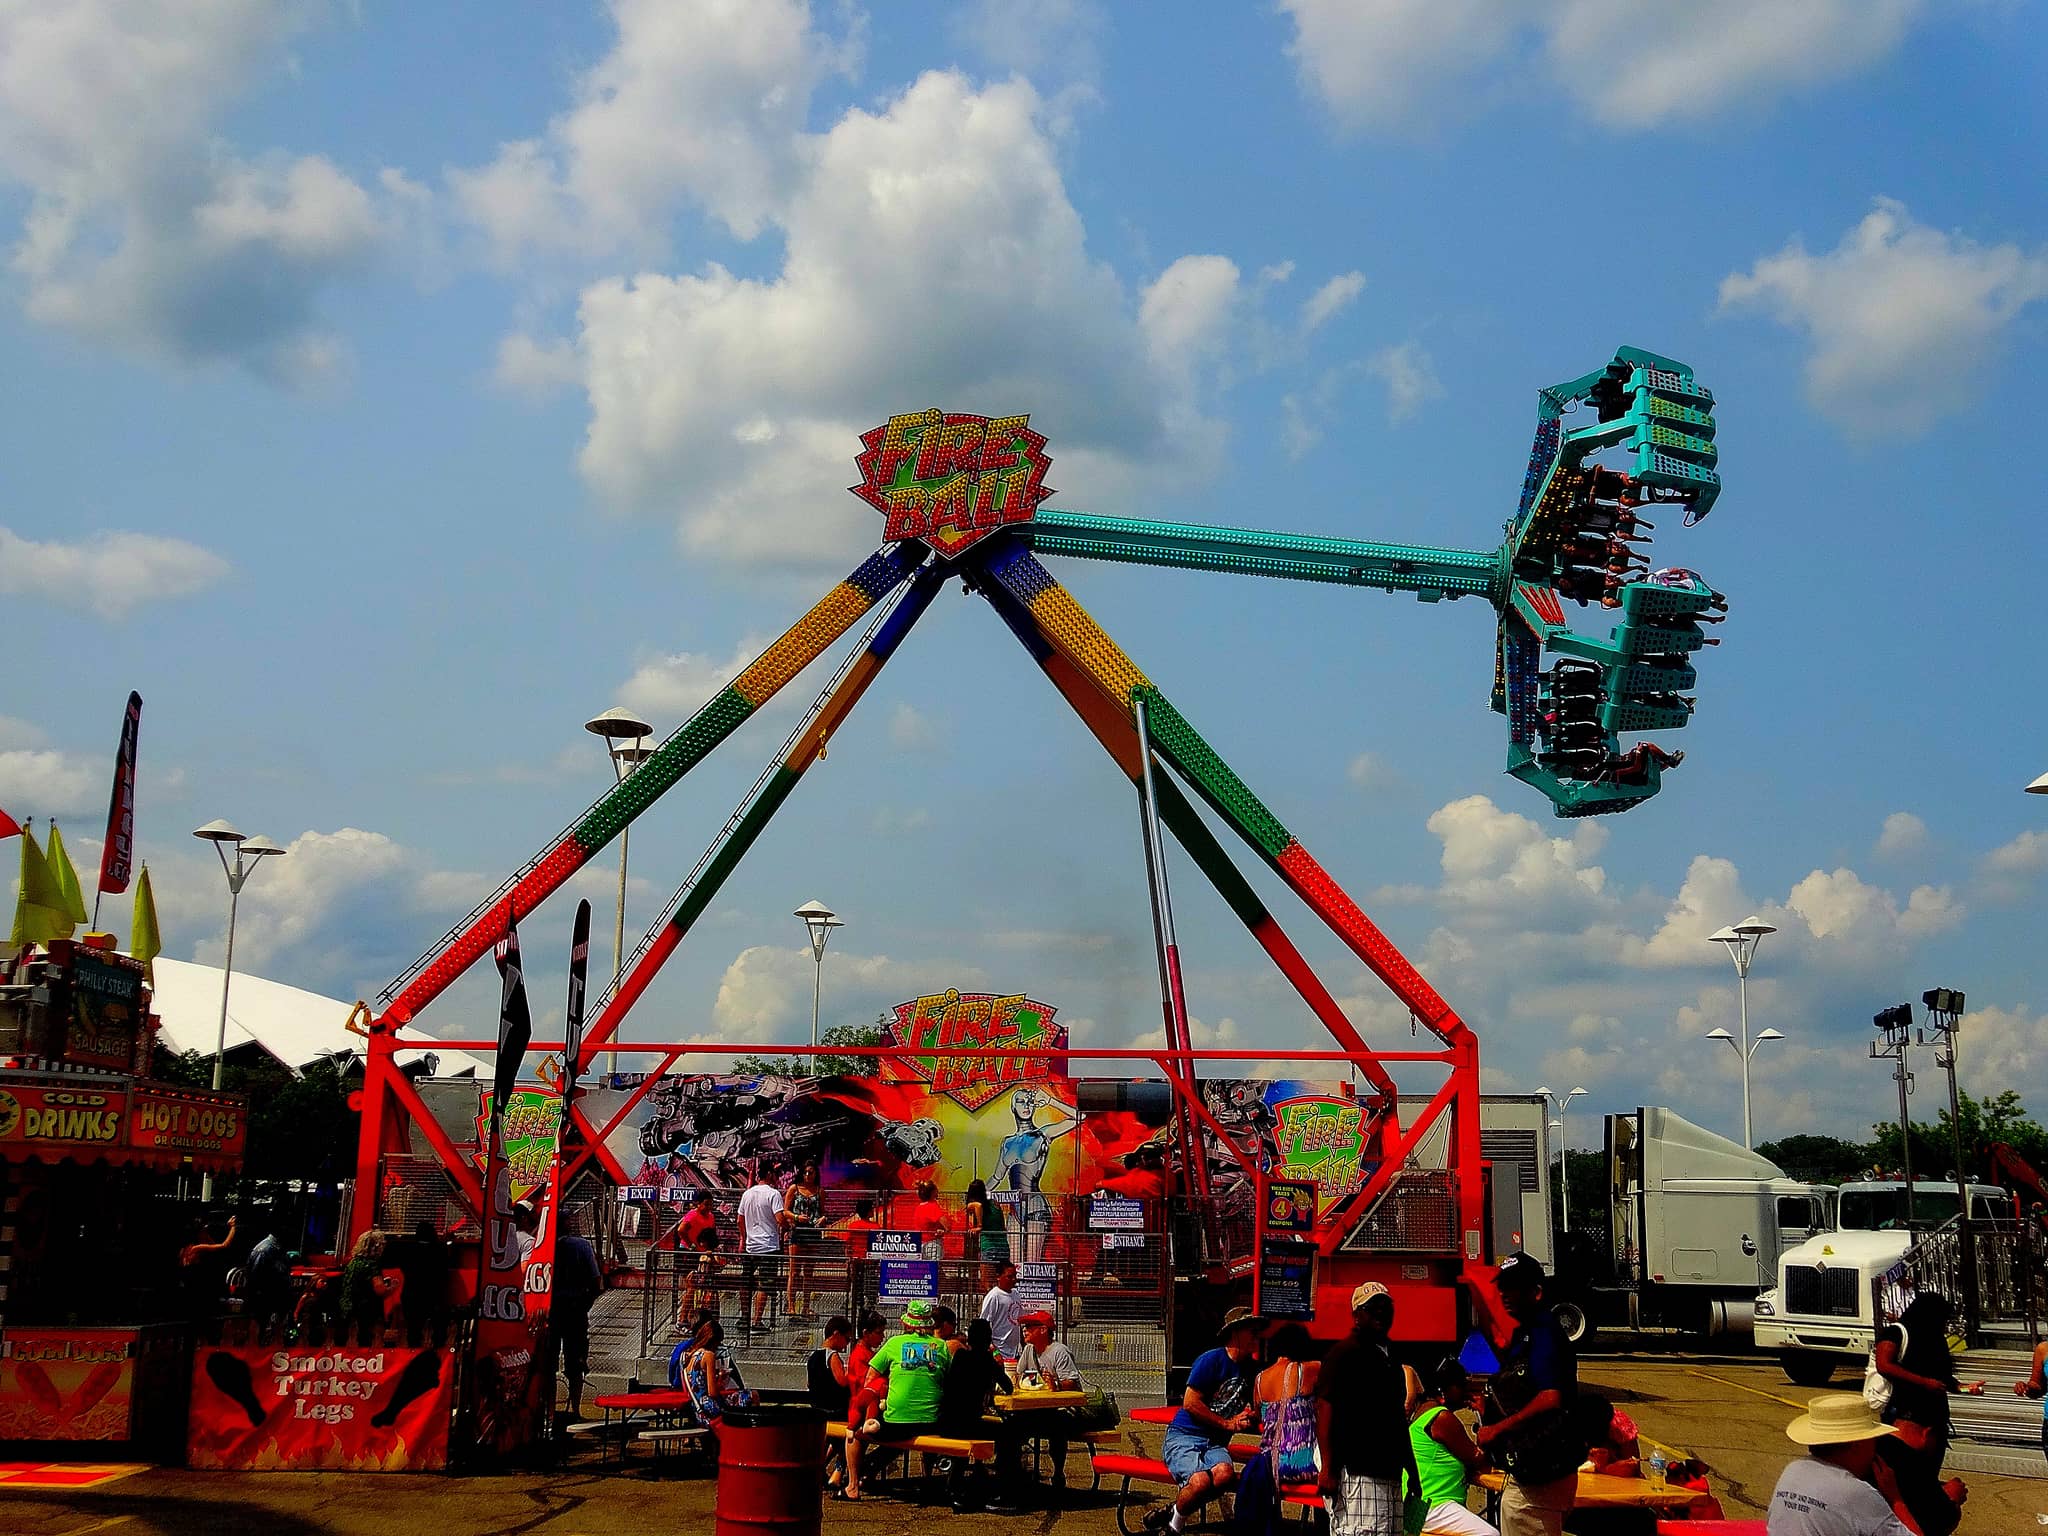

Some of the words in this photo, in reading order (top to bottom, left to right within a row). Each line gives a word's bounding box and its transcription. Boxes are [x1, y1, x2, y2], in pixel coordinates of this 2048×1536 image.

[882, 467, 1041, 543] BALL
[79, 968, 107, 991] PHILLY
[107, 977, 134, 998] STEAK
[74, 1033, 129, 1057] SAUSAGE
[930, 1032, 1050, 1094] BALL
[42, 1092, 107, 1106] COLD
[24, 1107, 120, 1141] DRINKS
[140, 1101, 181, 1132] HOT
[186, 1106, 238, 1139] DOGS
[154, 1134, 168, 1146] OR
[196, 1139, 222, 1150] DOGS
[630, 1188, 654, 1199] EXIT
[672, 1189, 695, 1201] EXIT
[1274, 1200, 1287, 1216] 4
[871, 1242, 917, 1252] RUNNING
[886, 1234, 902, 1243] NO
[1114, 1235, 1145, 1247] ENTRANCE
[523, 1262, 552, 1293] EGS
[1023, 1263, 1057, 1277] ENTRANCE
[478, 1285, 526, 1320] EGS
[271, 1351, 385, 1374] Smoked
[274, 1375, 379, 1401] Turkey
[294, 1398, 355, 1424] Legs
